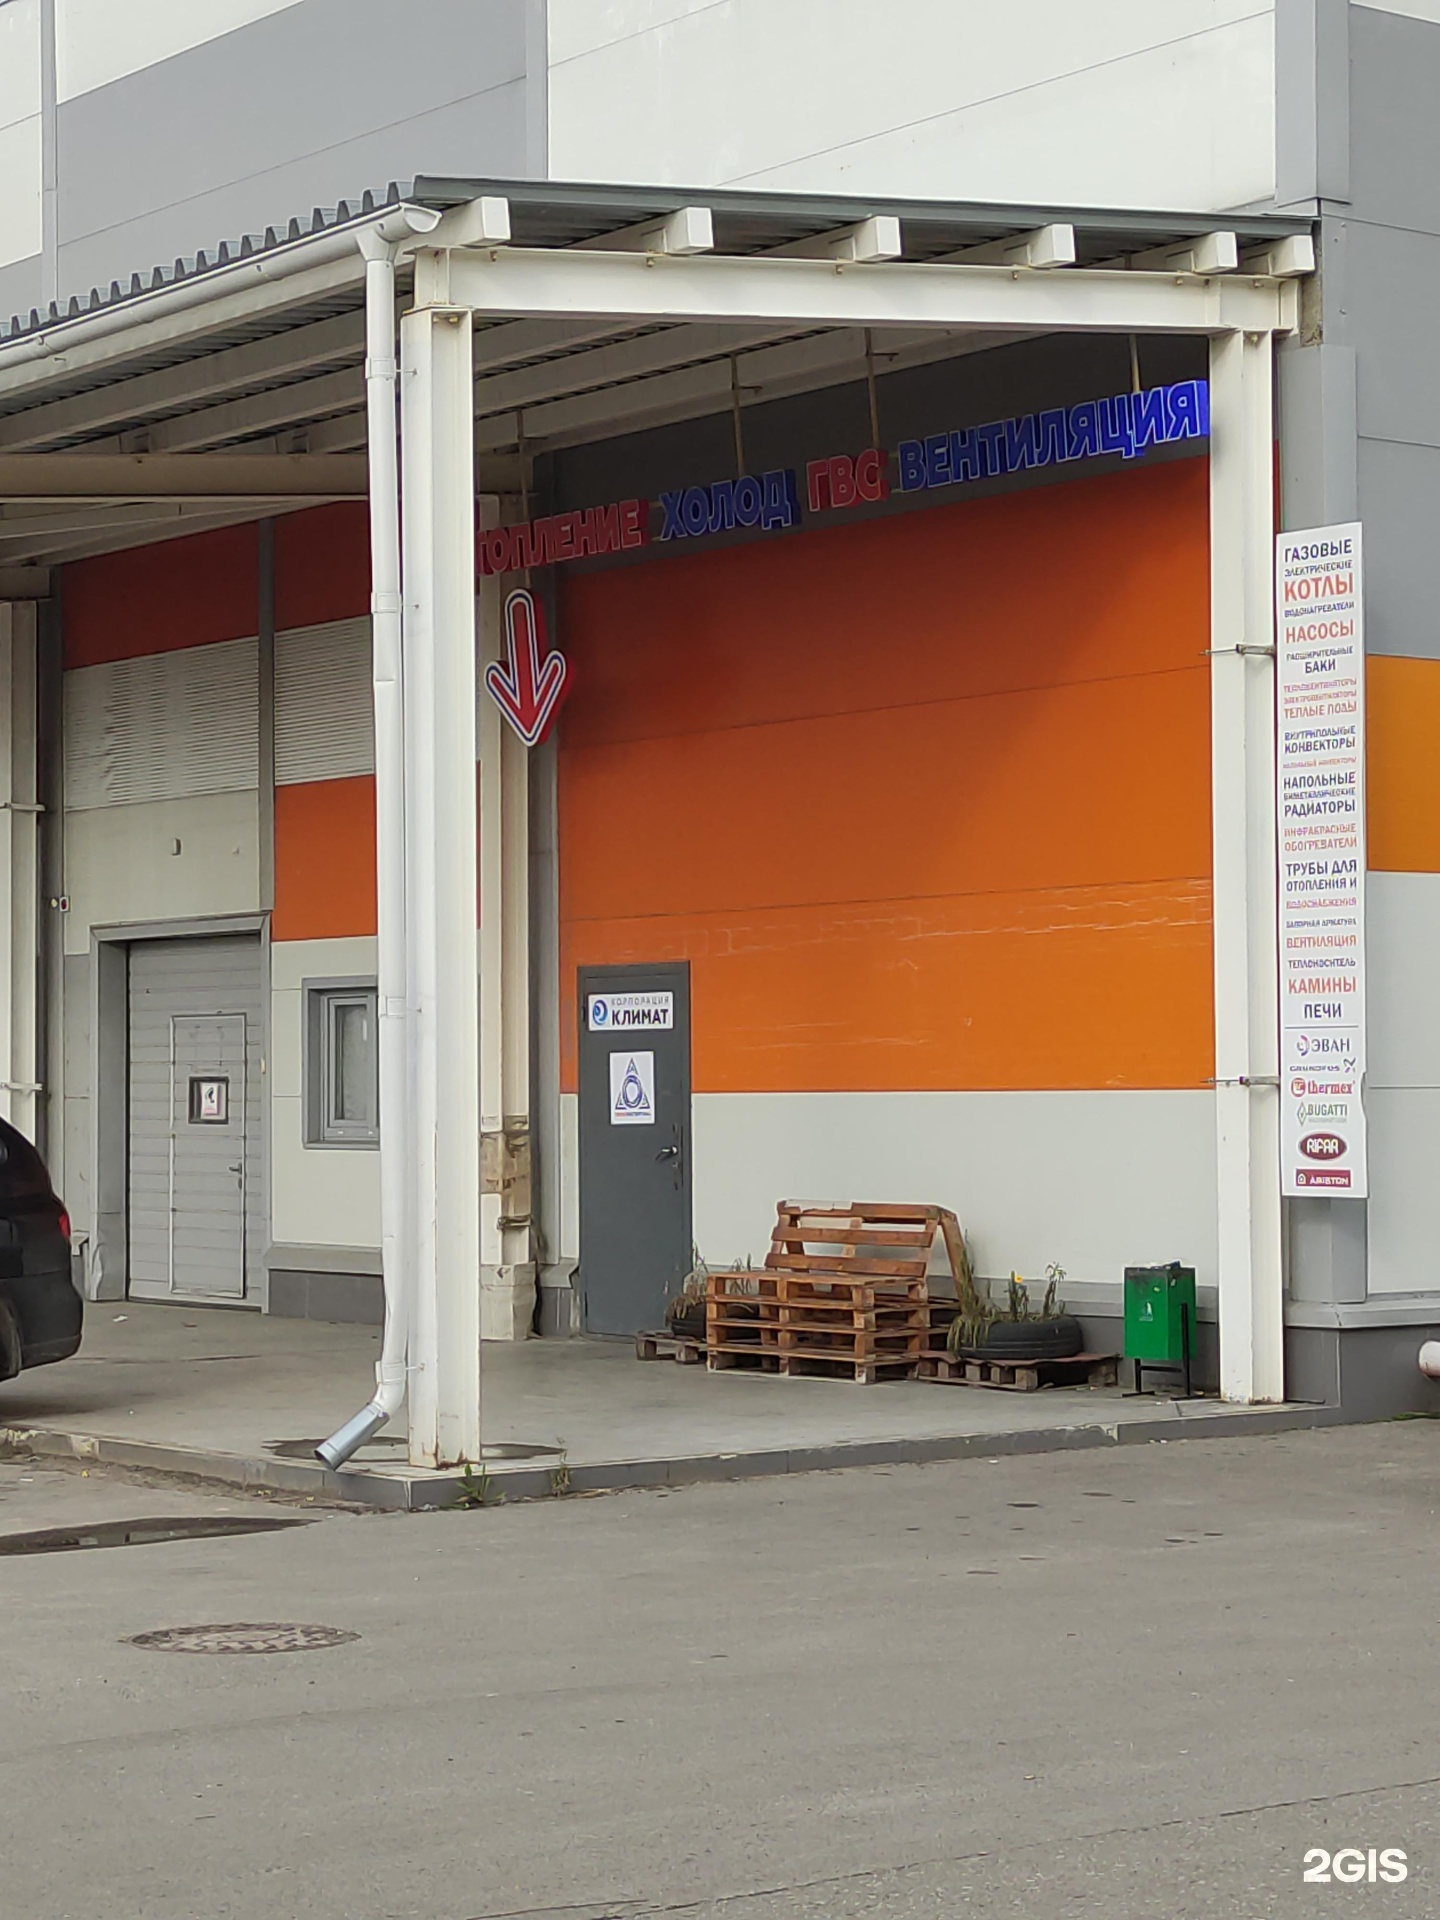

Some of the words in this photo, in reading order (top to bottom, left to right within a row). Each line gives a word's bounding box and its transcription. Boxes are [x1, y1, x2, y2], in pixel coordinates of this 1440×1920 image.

[659, 470, 796, 541] ХОЛОД
[807, 449, 886, 512] ГВС
[898, 381, 1206, 492] ВЕНТИЛЯЦИЯ
[1285, 539, 1352, 563] ГАЗОВЫЕ
[1284, 560, 1353, 577] ЭЛЕКТРИЧЕСКИЕ
[1284, 572, 1354, 603] КОТЛЫ
[1284, 602, 1354, 618] ВОДОНАГРЕВАТЕЛИ
[1286, 619, 1354, 644] НАСОСЫ
[1286, 646, 1354, 661] РАСШИРИТЕЛЬНЫЕ
[1305, 659, 1336, 674] БАКИ
[1284, 704, 1325, 719] ТЕПЛЫЕ
[1327, 701, 1357, 716] ПОЛЫ
[1284, 737, 1355, 755] КОНВЕКТОРЫ
[1284, 771, 1356, 790] НАПОЛЬНЫЕ
[1284, 799, 1355, 818] РАДИАТОРЫ
[1284, 823, 1356, 837] ИНФРАКРАСНЫЕ
[1284, 836, 1357, 853] ОБОГРЕВАТЕЛИ
[1285, 861, 1328, 877] ТРУБЫ
[1332, 859, 1357, 876] ДЛЯ
[1286, 878, 1346, 892] ОТОПЛЕНИЯ
[1350, 877, 1357, 890] И
[1286, 935, 1357, 949] ВЕНТИЛЯЦИЯ
[1288, 957, 1356, 970] ТЕПЛОНОСИТЕЛЬ
[1288, 976, 1356, 994] КАМИНЫ
[611, 996, 669, 1007] КОРПОРАЦИЯ
[611, 1009, 669, 1026] КЛИМАТ
[1304, 1003, 1342, 1019] ПЕЧИ
[1311, 1037, 1350, 1053] ЭВАН
[1308, 1104, 1348, 1116] BUGATTI
[1310, 1176, 1349, 1185] ARISTON
